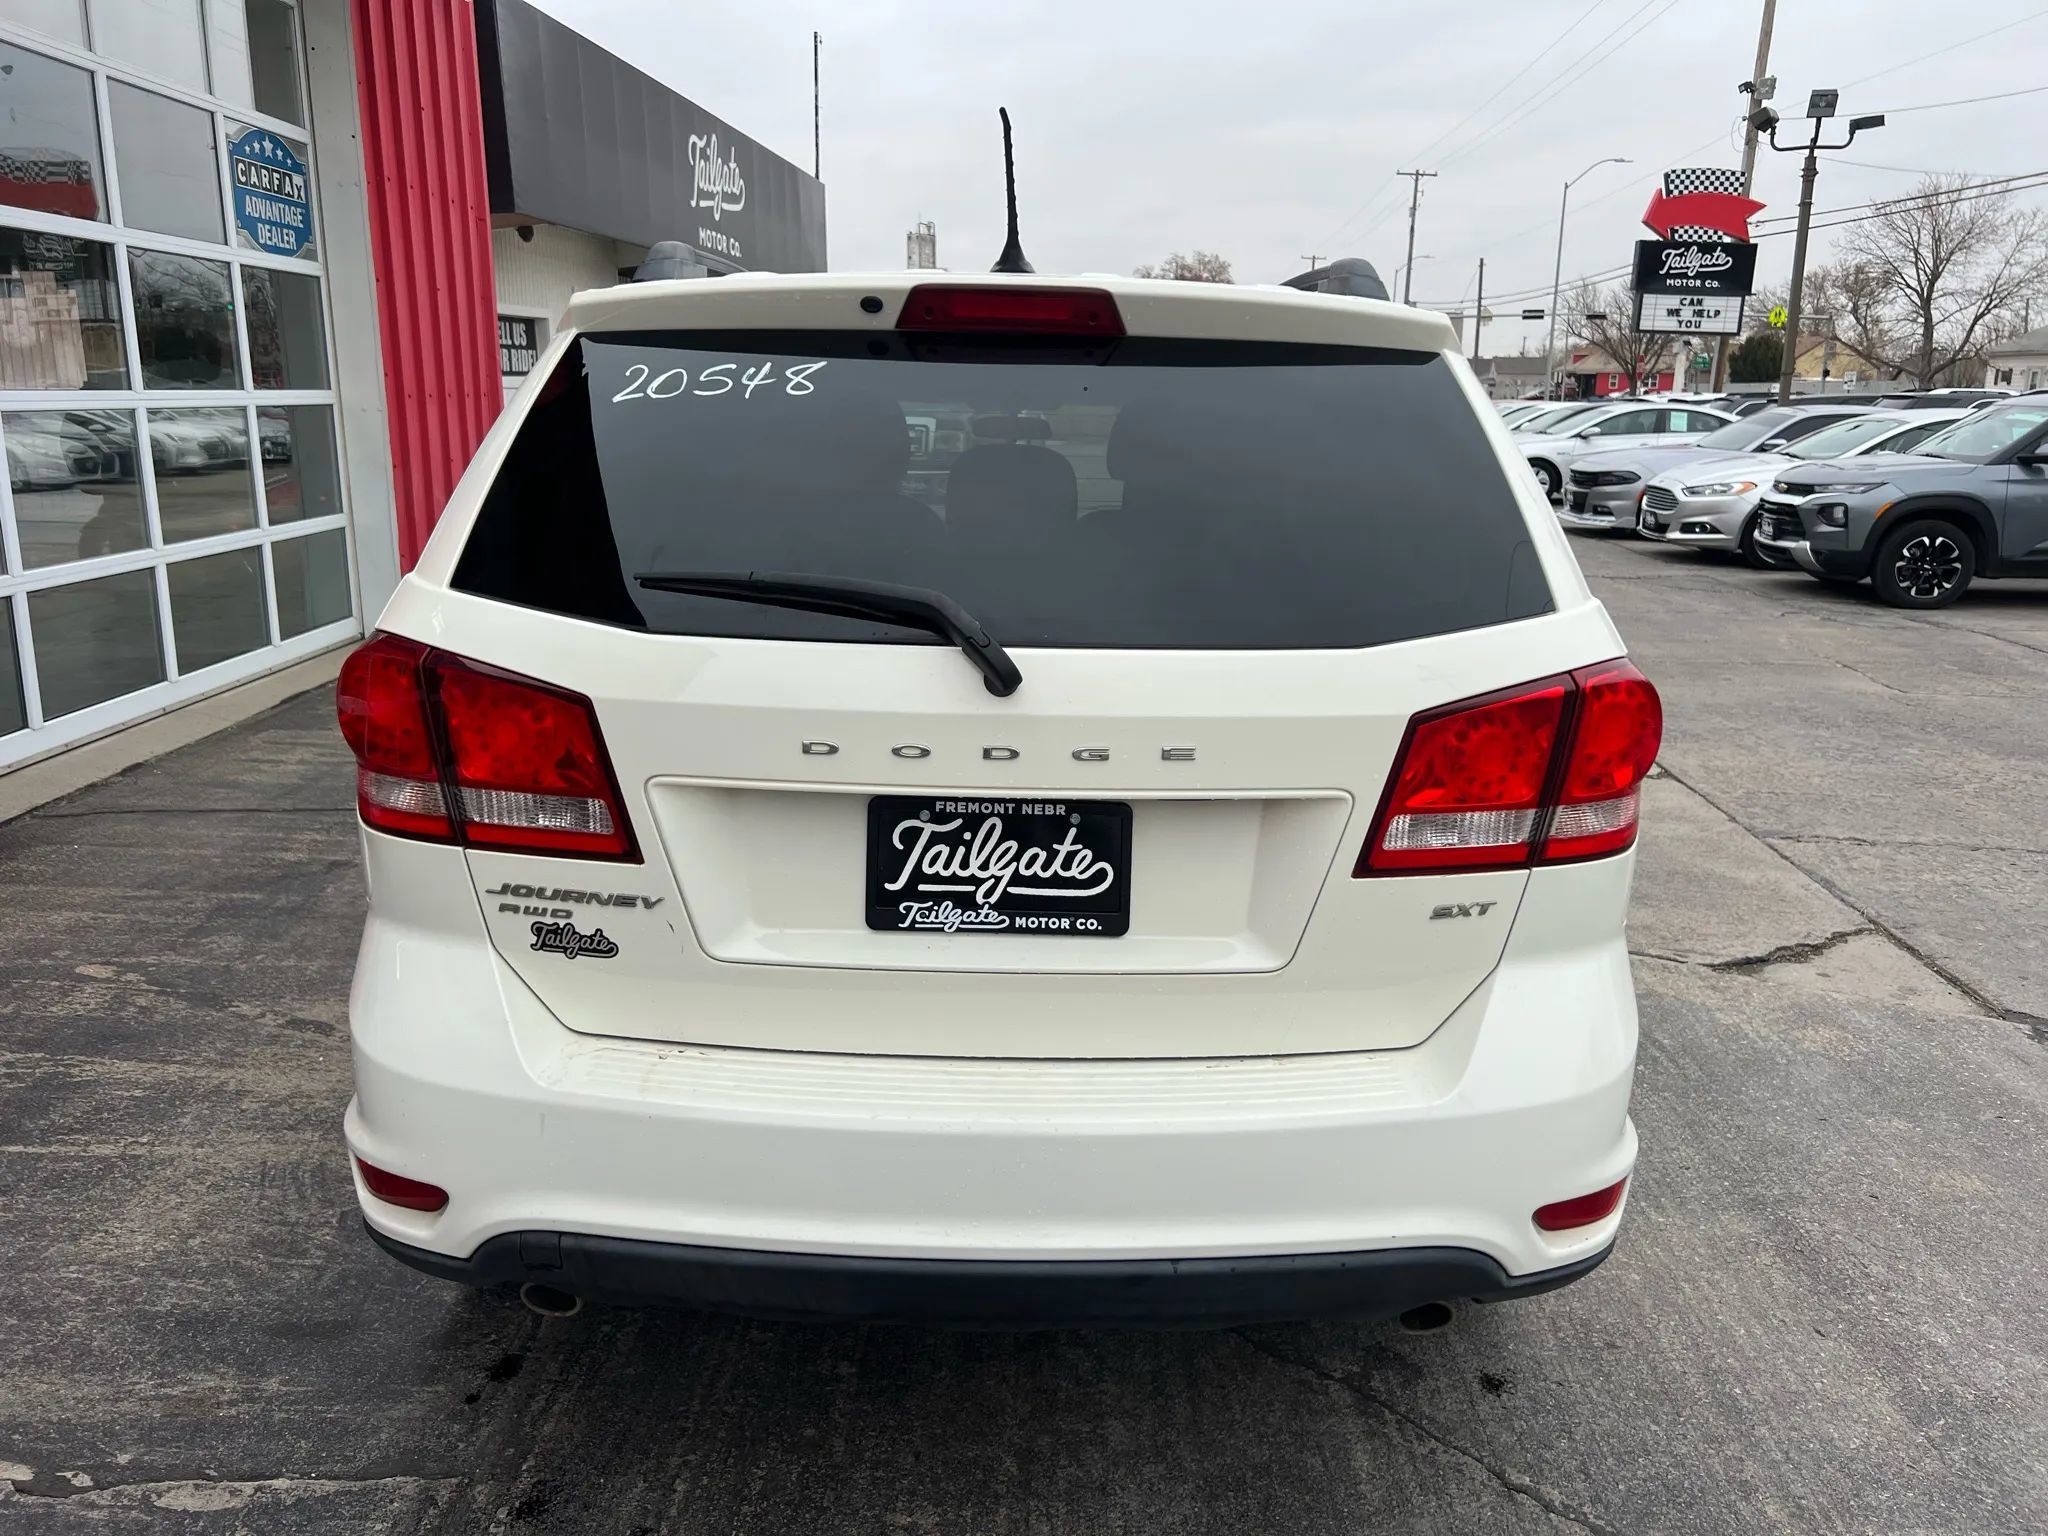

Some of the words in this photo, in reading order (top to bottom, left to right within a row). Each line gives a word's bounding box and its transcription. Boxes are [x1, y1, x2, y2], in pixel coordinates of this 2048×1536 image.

[237, 162, 304, 201] CARFAX
[688, 133, 746, 221] Tailgate
[245, 195, 304, 228] ADVANTAGE
[257, 222, 297, 250] DEALER
[699, 226, 728, 254] MOTOR
[1659, 245, 1733, 276] Tailgate
[1666, 279, 1701, 287] MOTOR
[1666, 308, 1682, 317] WE
[1692, 309, 1720, 318] HELP
[1680, 298, 1704, 306] CAN
[512, 323, 527, 346] US
[1677, 320, 1702, 328] YOU
[612, 361, 827, 403] 20548
[802, 740, 1196, 761] DODGE
[935, 801, 1015, 815] FREMONT
[1021, 802, 1066, 816] NEBR
[884, 816, 1114, 905] Tailgate
[485, 882, 665, 910] JOURNEY
[1429, 900, 1498, 920] SXT
[898, 900, 1010, 932] Tailgate
[1015, 917, 1070, 930] MOTOR
[1076, 918, 1102, 930] CO.
[531, 921, 618, 958] Tailgate
